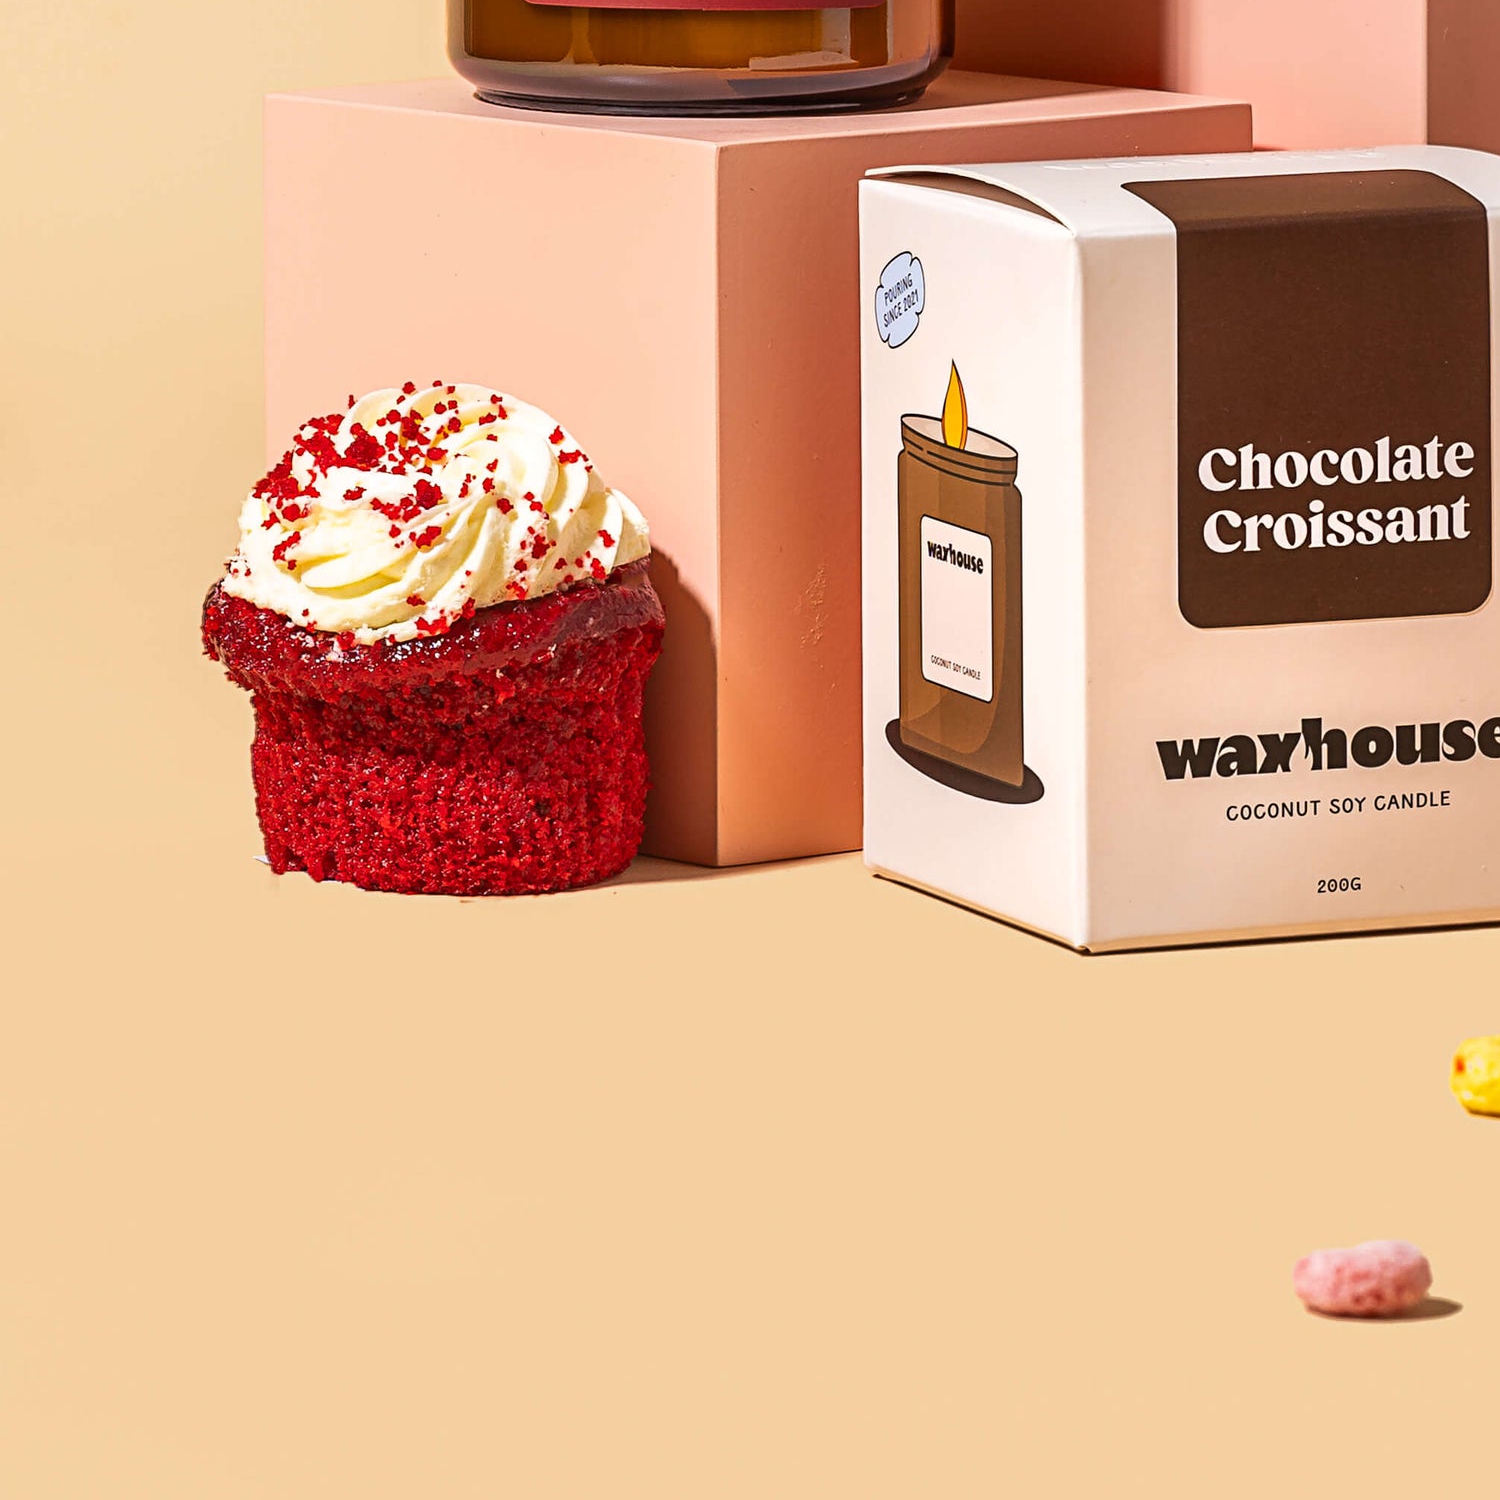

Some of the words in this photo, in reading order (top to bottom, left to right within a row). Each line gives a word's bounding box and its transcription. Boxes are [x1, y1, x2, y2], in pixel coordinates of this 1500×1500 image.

[884, 273, 913, 306] POURING
[883, 301, 902, 327] SINCE
[903, 289, 919, 312] 2021
[1199, 436, 1474, 491] Chocolate
[1204, 496, 1470, 553] Croissant
[927, 541, 983, 574] waxhouse
[931, 655, 952, 669] COCONUT
[952, 662, 962, 673] SOY
[962, 666, 981, 680] CANDLE
[1226, 799, 1320, 822] COCONUT
[1329, 796, 1366, 815] SOY
[1374, 790, 1450, 811] CANDLE
[1317, 876, 1361, 894] 200G
